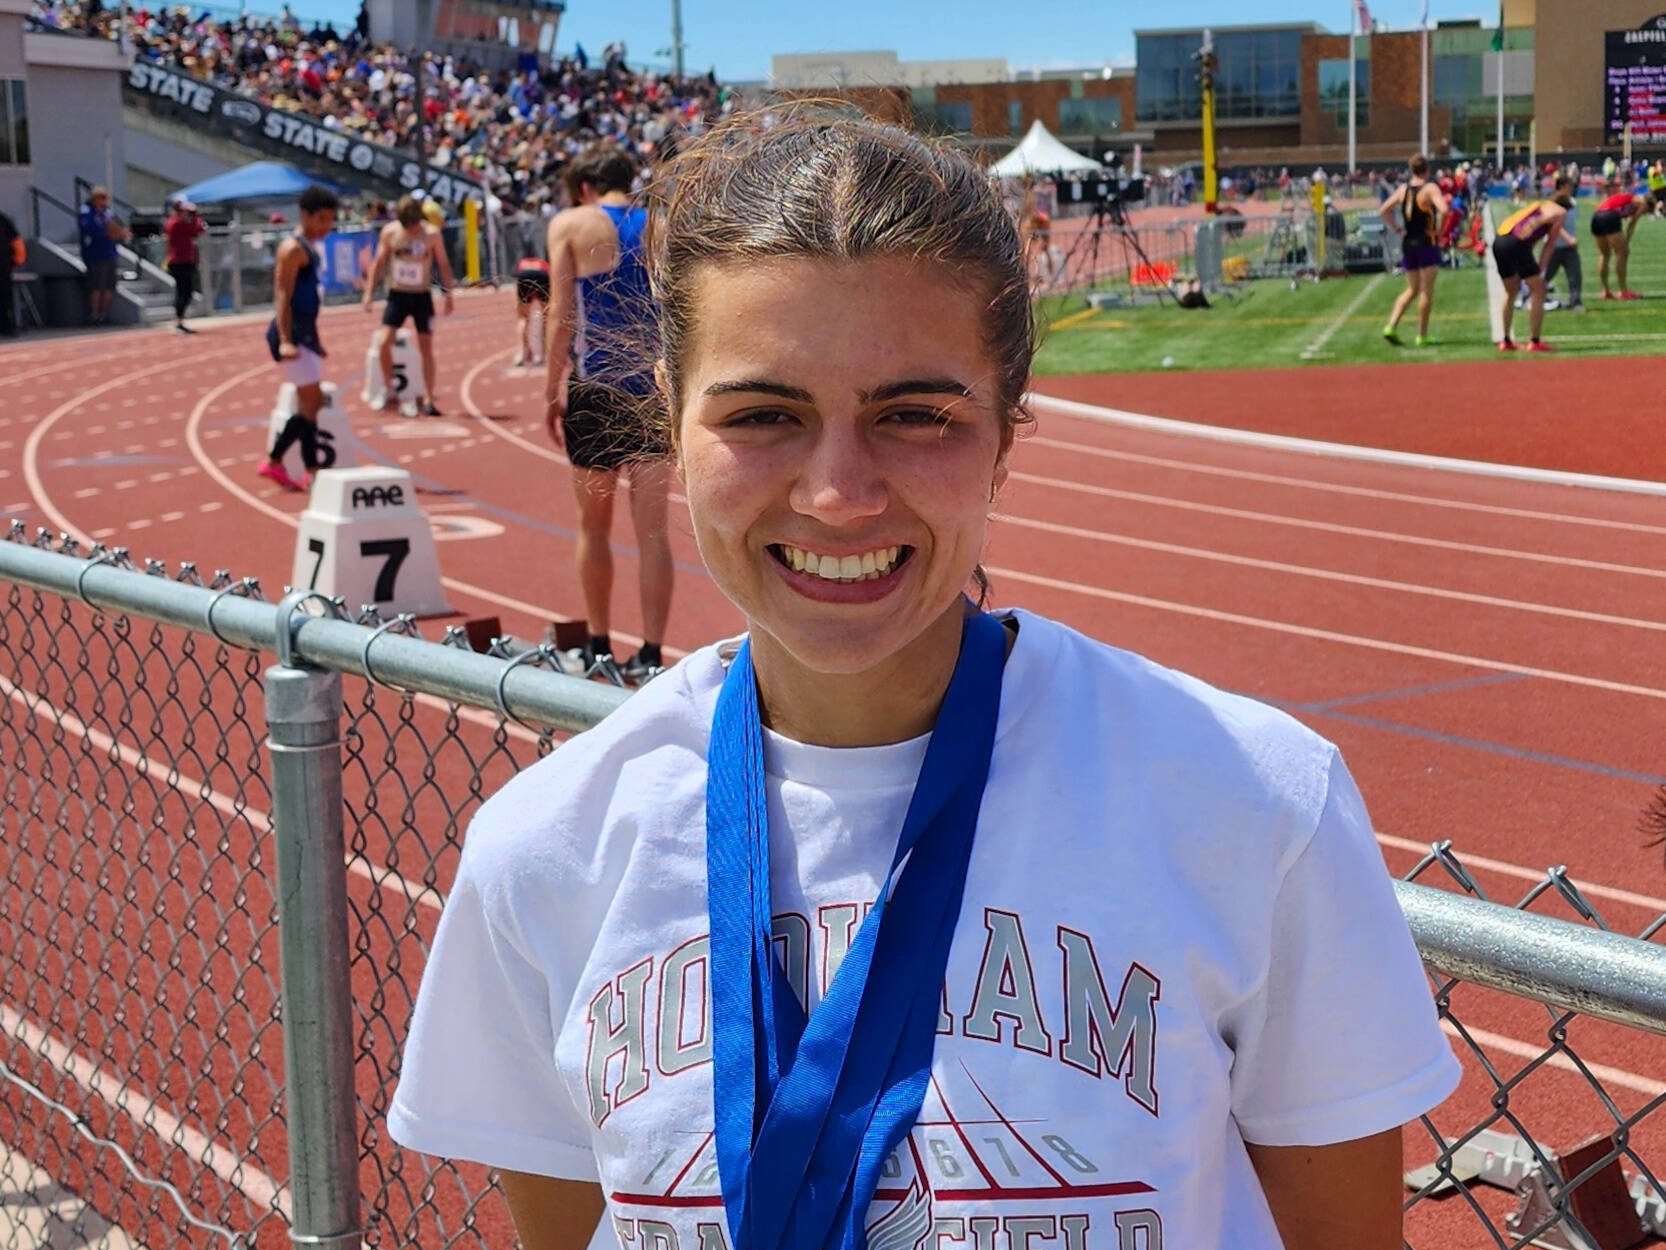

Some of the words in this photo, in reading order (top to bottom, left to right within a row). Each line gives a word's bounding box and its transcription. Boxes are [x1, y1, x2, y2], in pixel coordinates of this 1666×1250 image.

[128, 62, 215, 113] STATE
[263, 112, 349, 163] STATE
[308, 537, 326, 589] 7
[359, 537, 411, 603] 7
[928, 1138, 965, 1179] 6
[983, 1137, 1021, 1178] 7
[1040, 1134, 1100, 1174] 8
